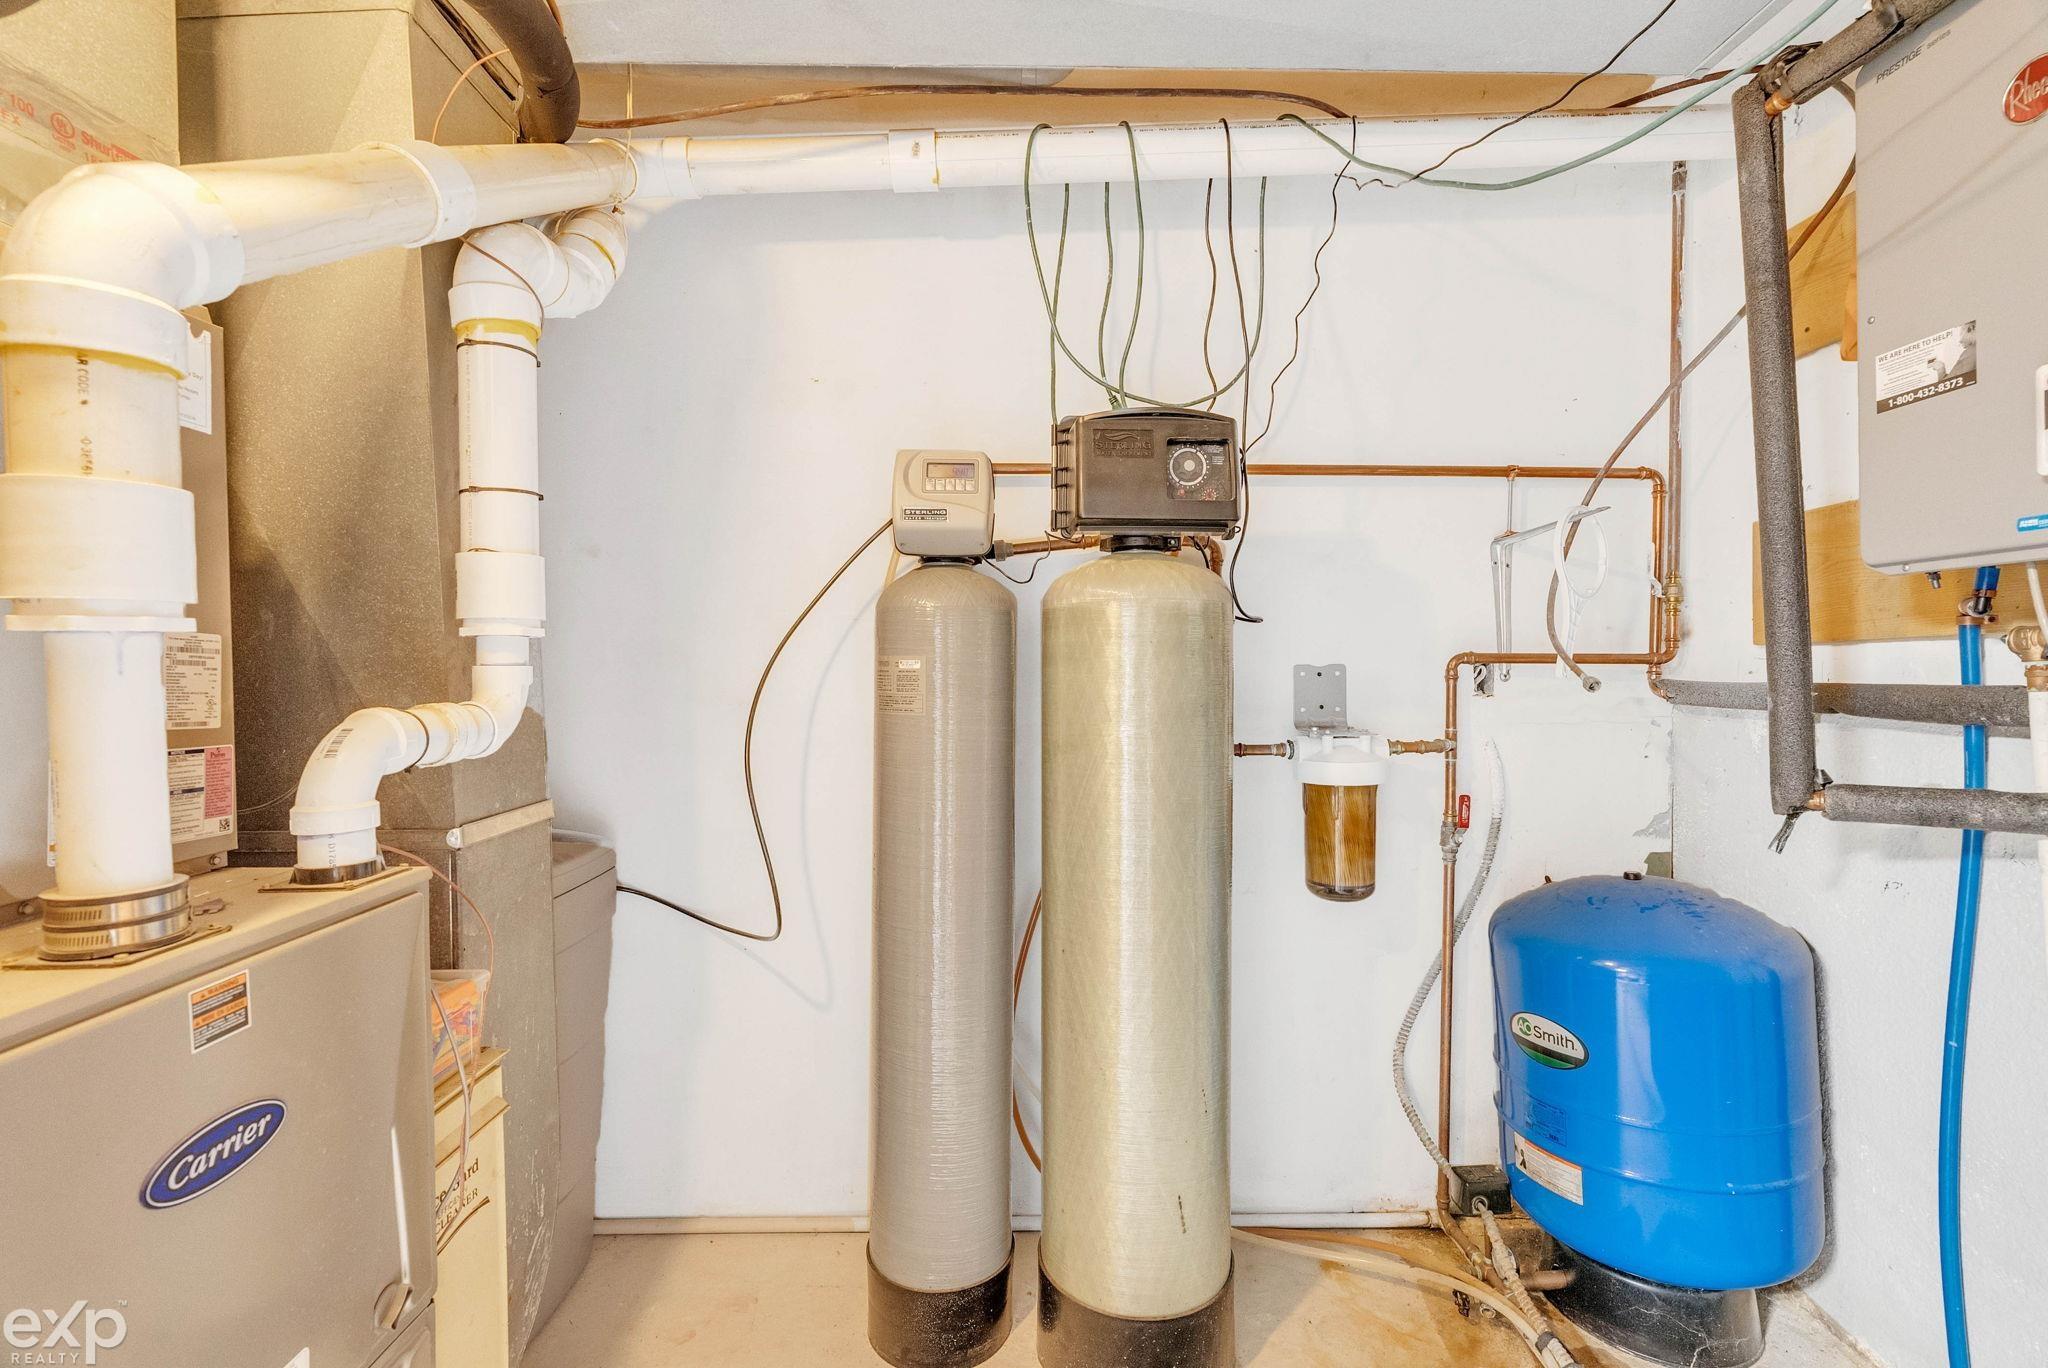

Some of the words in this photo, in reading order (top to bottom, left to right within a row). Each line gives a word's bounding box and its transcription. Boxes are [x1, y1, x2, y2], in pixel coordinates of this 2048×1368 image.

[1876, 45, 1922, 84] PRESTIGE
[1926, 29, 1952, 50] series
[2008, 66, 2048, 119] Rhee
[1878, 354, 1888, 363] WE
[1889, 349, 1902, 359] ARE
[1903, 343, 1921, 354] HERE
[1922, 339, 1932, 347] TO
[1932, 330, 1953, 342] HELP!
[1887, 377, 1964, 407] 1-800-432-8373
[1533, 1025, 1575, 1051] Smith
[167, 1113, 272, 1190] Carrier
